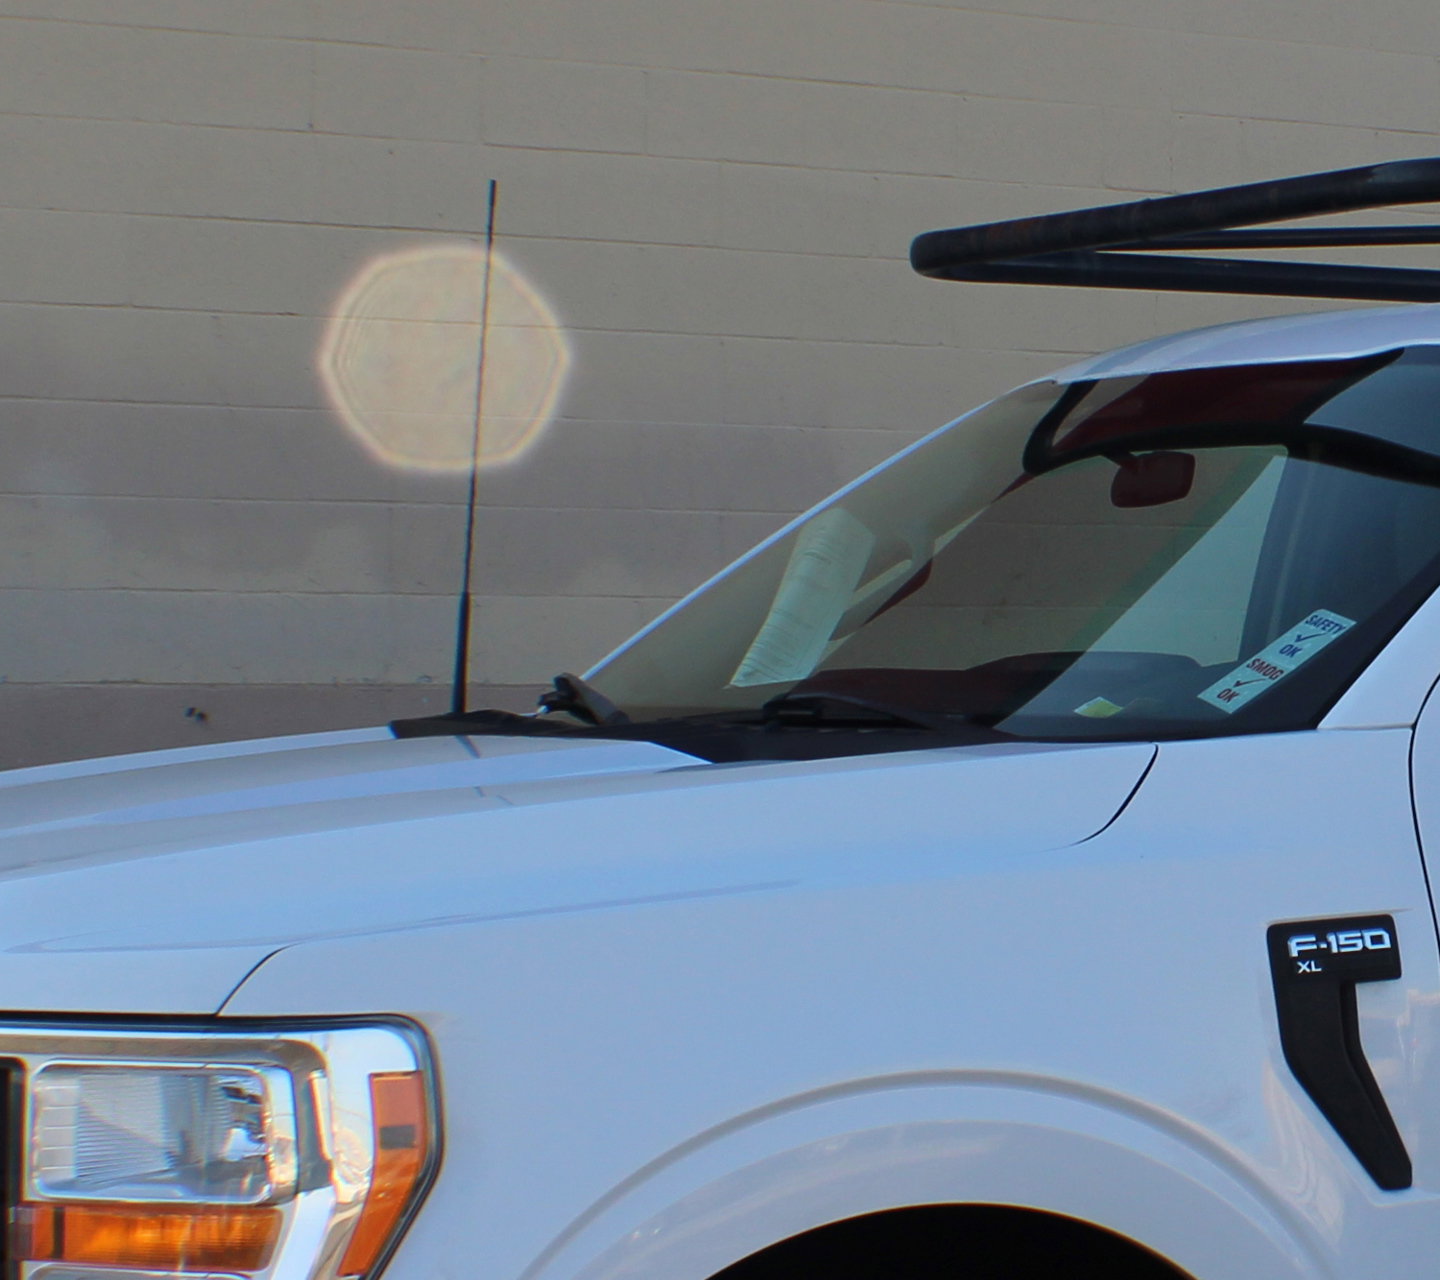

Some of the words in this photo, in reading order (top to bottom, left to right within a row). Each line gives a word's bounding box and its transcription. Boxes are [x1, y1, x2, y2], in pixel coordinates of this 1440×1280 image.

[1305, 615, 1346, 634] SAFETY
[1279, 644, 1302, 658] OK
[1247, 658, 1285, 680] SMOG
[1216, 688, 1240, 703] OK
[1288, 928, 1392, 957] F-150
[1297, 960, 1322, 974] XL
